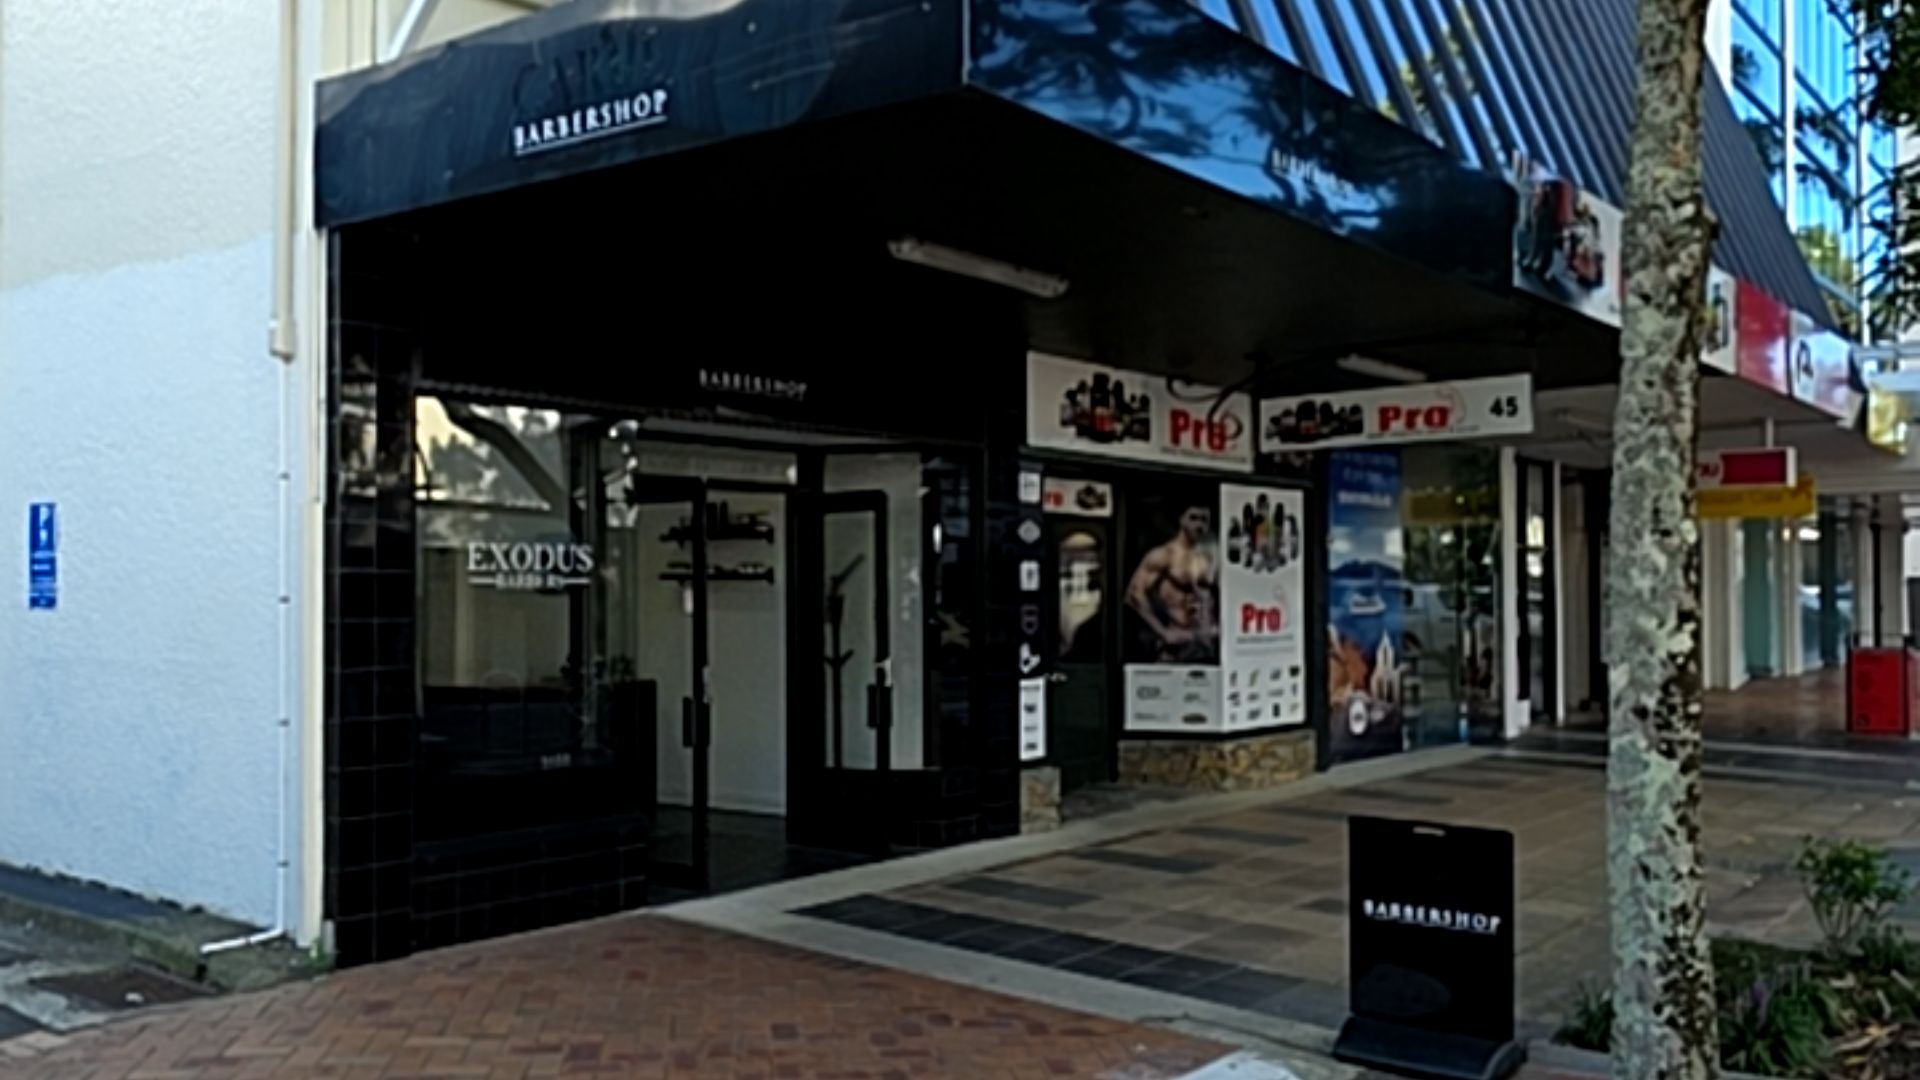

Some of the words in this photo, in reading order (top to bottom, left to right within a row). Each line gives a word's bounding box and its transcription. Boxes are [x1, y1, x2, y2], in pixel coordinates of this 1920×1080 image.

[513, 89, 668, 149] BARBERSHOP
[1376, 405, 1450, 433] Pro
[1489, 396, 1519, 418] 45
[466, 541, 595, 573] EXODUS
[1240, 602, 1282, 634] Pro
[1363, 898, 1502, 935] BARBERSHOP
